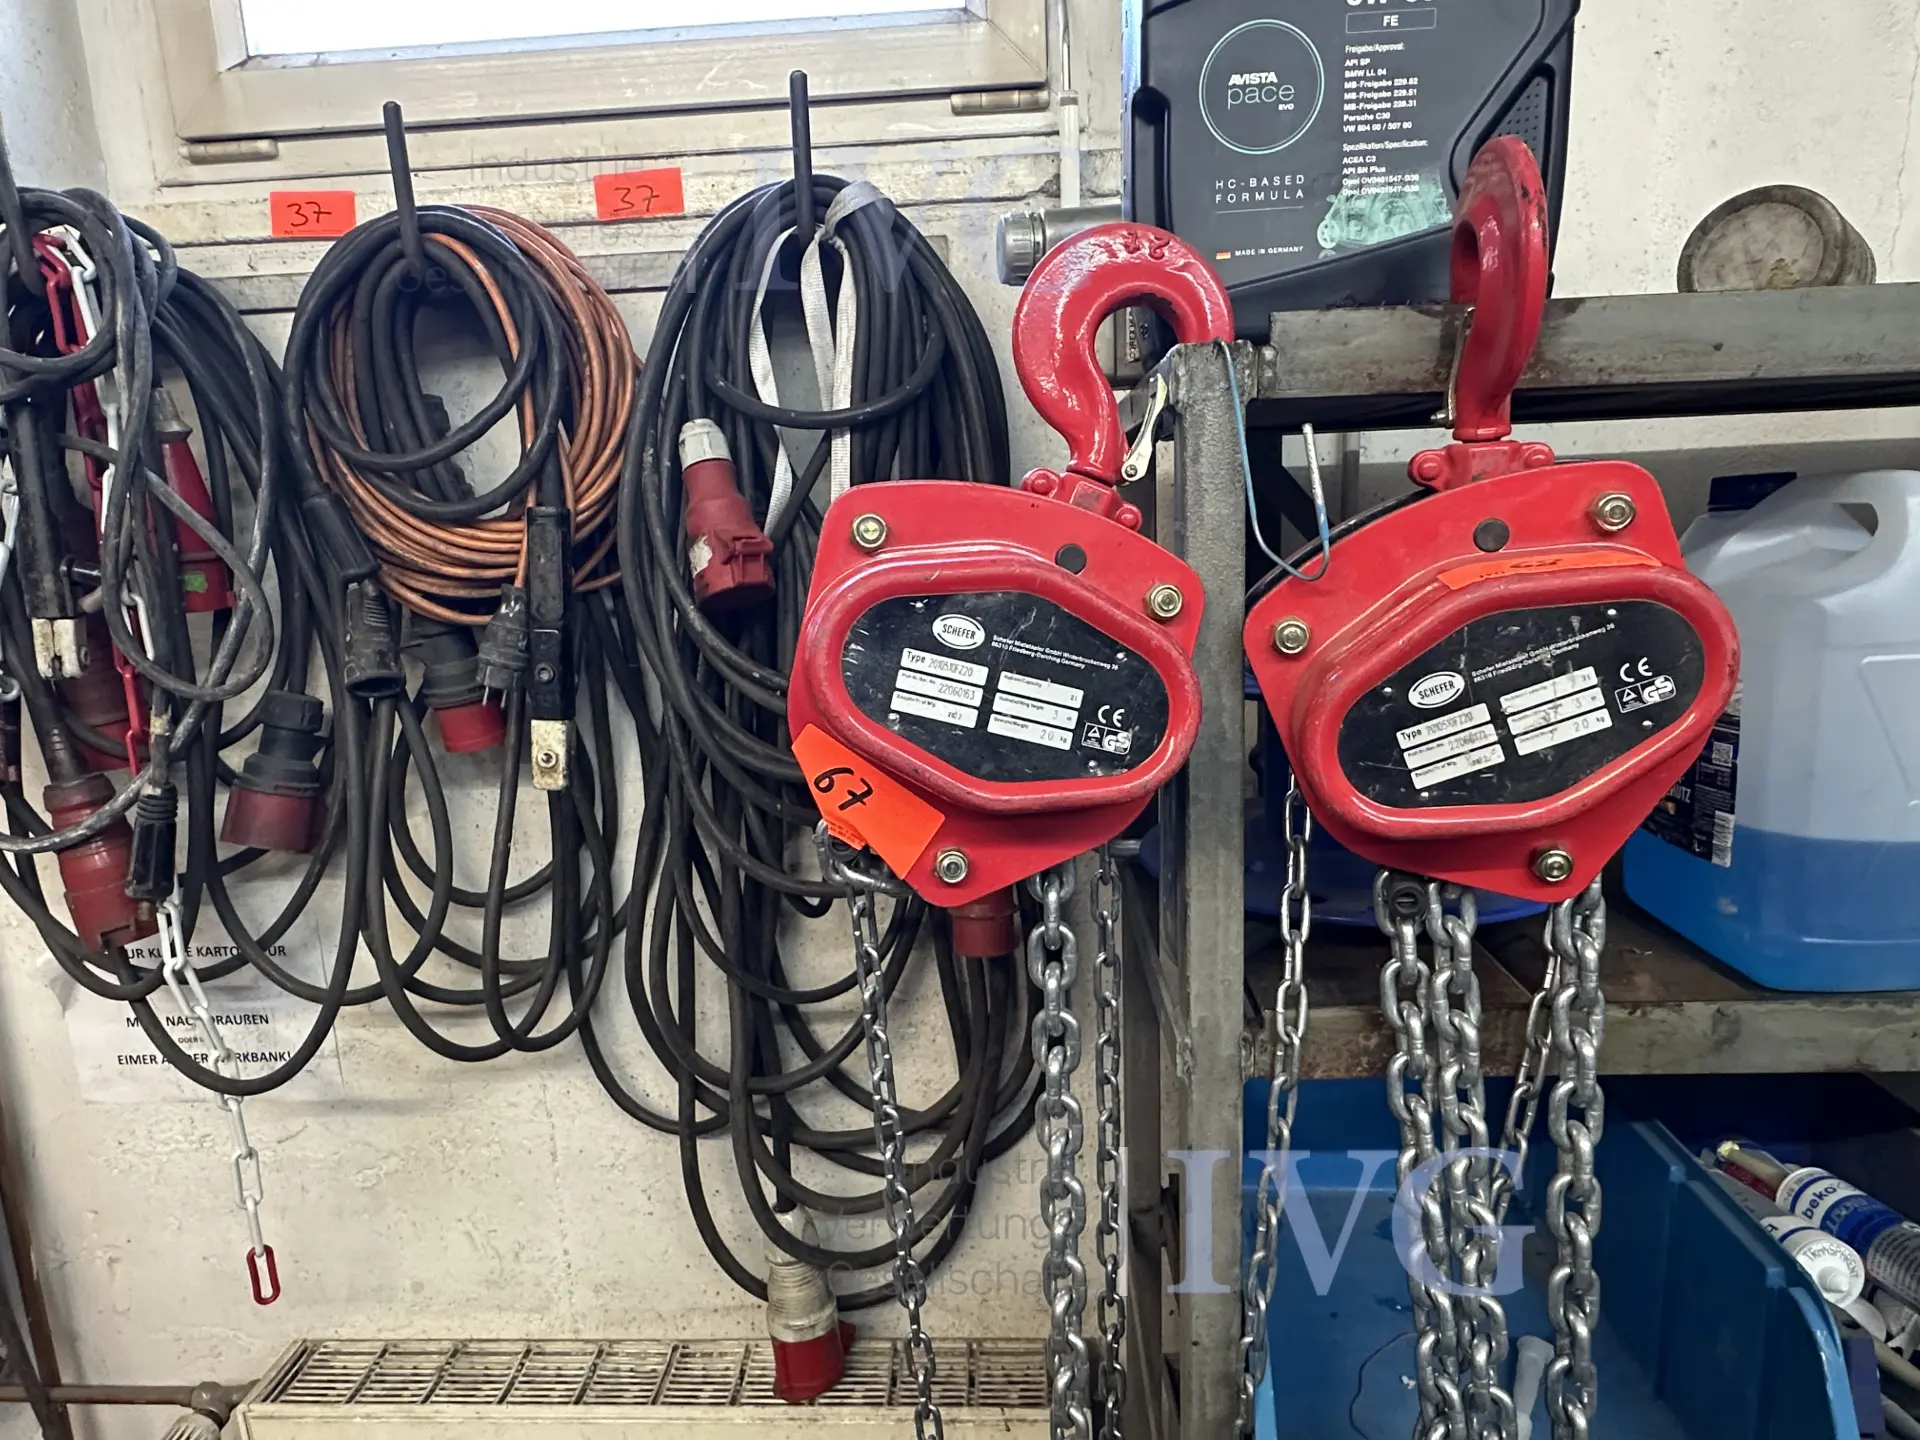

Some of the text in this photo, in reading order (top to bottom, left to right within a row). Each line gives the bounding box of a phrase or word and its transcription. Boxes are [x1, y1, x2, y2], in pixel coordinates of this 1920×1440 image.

[1382, 14, 1399, 26] FE
[1228, 72, 1278, 86] AVISTA
[1344, 70, 1365, 78] BMW
[1366, 68, 1375, 76] LL
[1344, 80, 1392, 89] MB-Freigabe
[1228, 84, 1295, 110] pace
[1344, 91, 1392, 100] MB-Freigabe
[1344, 102, 1391, 111] MB-Freigabe
[1343, 113, 1374, 122] Porsche
[1342, 156, 1364, 164] ACEA
[1342, 167, 1355, 175] API
[1216, 174, 1304, 190] HC-BASED
[613, 185, 660, 212] 37
[1216, 189, 1304, 204] FORMULA
[286, 201, 332, 226] 37
[1268, 246, 1304, 254] GERMANY
[942, 624, 976, 640] SCHEFER
[907, 651, 926, 663] Type
[1620, 657, 1653, 682] CE
[1418, 680, 1455, 700] SCHEFER
[1643, 677, 1673, 702] GS
[1098, 705, 1125, 728] CE
[1573, 718, 1589, 732] 20
[1040, 730, 1055, 741] 20
[1105, 732, 1131, 751] GS
[1401, 729, 1422, 742] Type
[814, 767, 874, 811] 67
[166, 1016, 193, 1026] NAC
[118, 1054, 158, 1065] EIMER
[235, 1051, 291, 1062] RKBANK!
[1802, 1186, 1837, 1220] beko
